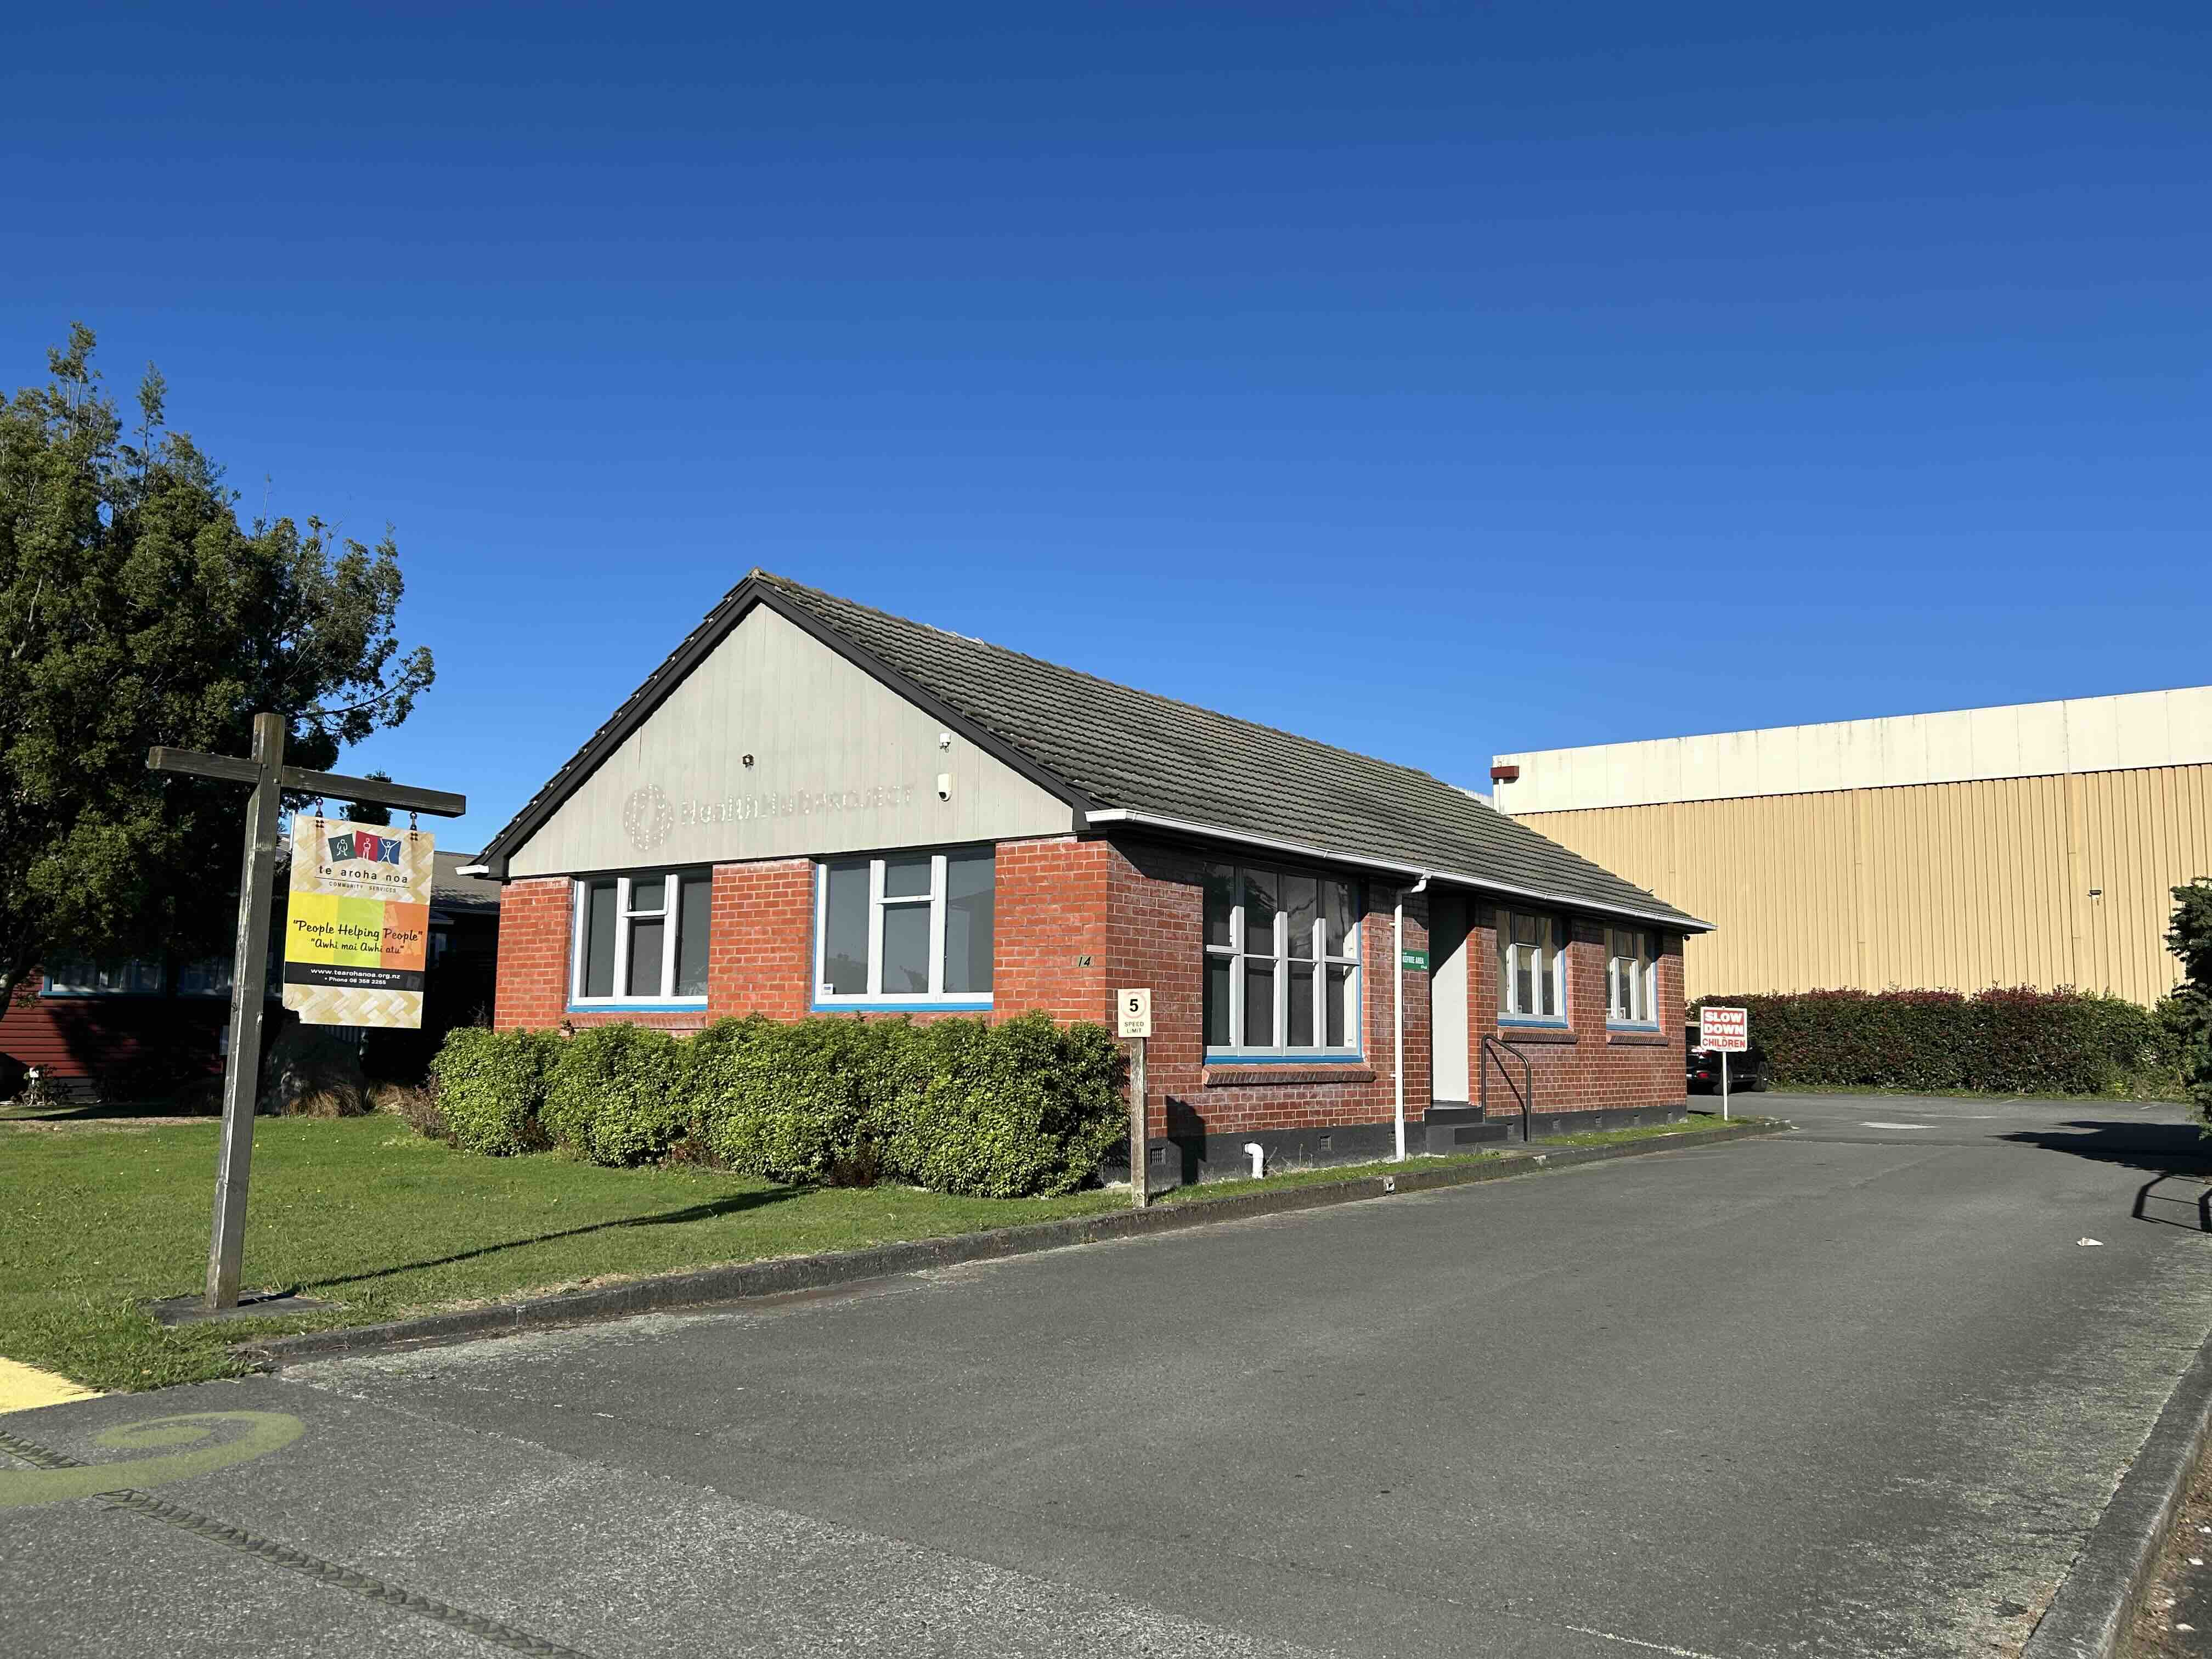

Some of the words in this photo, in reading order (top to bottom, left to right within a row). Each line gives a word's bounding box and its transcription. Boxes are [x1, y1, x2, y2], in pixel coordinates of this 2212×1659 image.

[319, 865, 332, 874] te
[341, 870, 377, 880] aroha
[386, 874, 408, 883] noa
[293, 919, 334, 936] "People
[338, 924, 380, 941] Helping
[383, 927, 423, 943] People"
[311, 938, 338, 950] "Awhi
[341, 943, 357, 951] mai
[360, 942, 382, 952] Awhi
[386, 946, 404, 954] atu"
[1078, 956, 1091, 967] 14
[311, 968, 400, 979] www.tearohanoa.org.nz
[1130, 998, 1139, 1012] 5
[1705, 1012, 1743, 1023] SLOW
[1703, 1023, 1743, 1035] DOWN
[1702, 1038, 1745, 1048] CHILDREN
